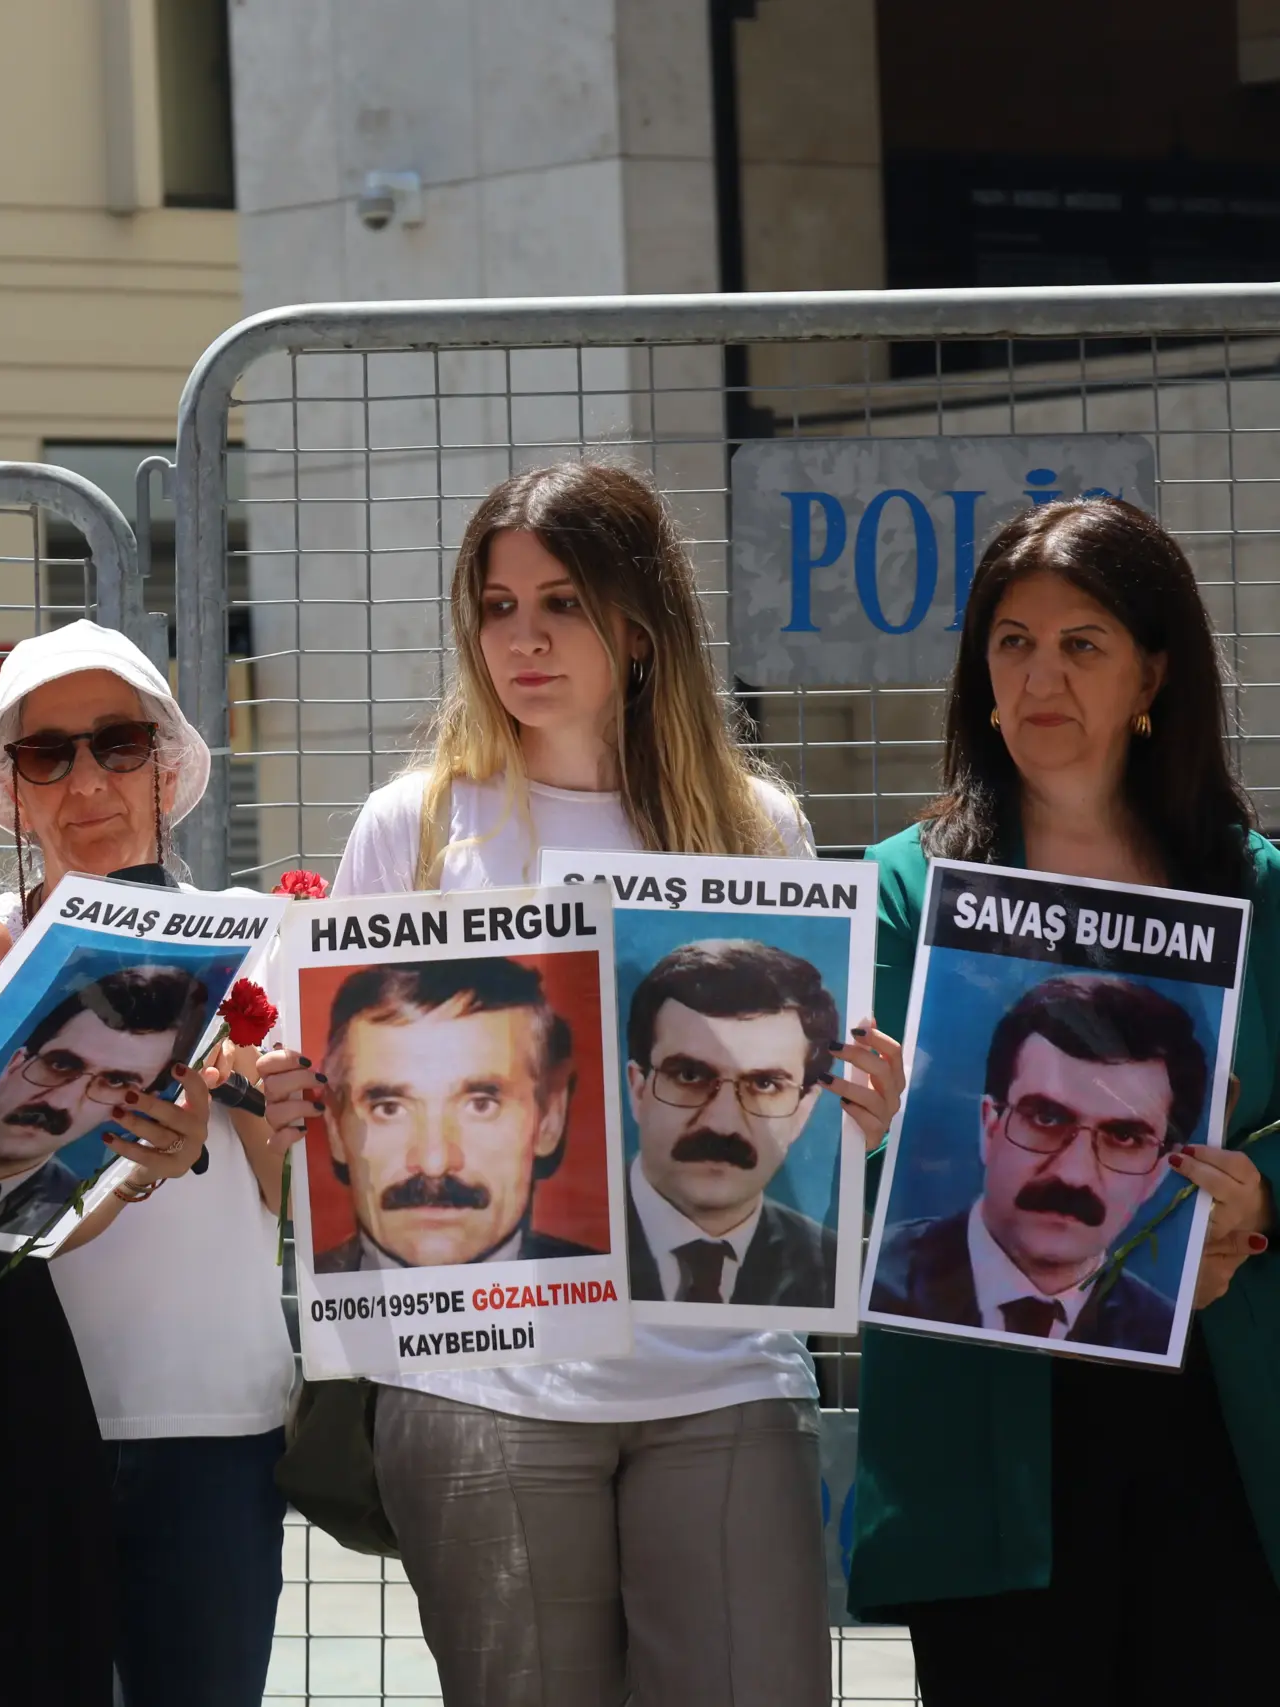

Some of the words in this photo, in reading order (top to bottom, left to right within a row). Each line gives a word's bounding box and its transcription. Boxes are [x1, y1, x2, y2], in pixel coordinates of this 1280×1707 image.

[780, 468, 1123, 635] POL
[701, 878, 858, 910] BULDAN
[59, 896, 160, 937] SAVAŞ
[162, 913, 269, 940] BULDAN
[311, 910, 448, 952] HASAN
[463, 902, 597, 943] ERGUL
[953, 892, 1067, 951] SAVAŞ
[1075, 908, 1216, 963] BULDAN
[472, 1279, 618, 1312] GÖZALTINDA
[398, 1321, 535, 1358] KAYBEDİLDİ
